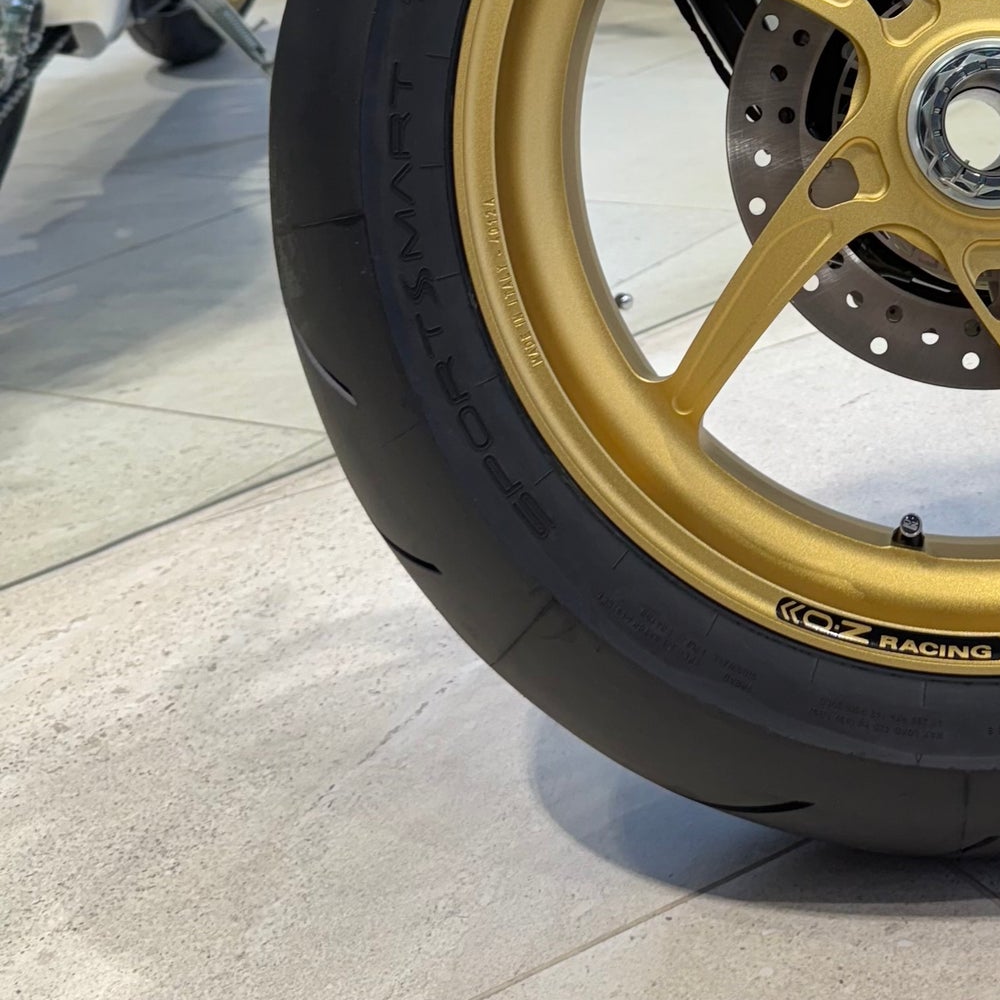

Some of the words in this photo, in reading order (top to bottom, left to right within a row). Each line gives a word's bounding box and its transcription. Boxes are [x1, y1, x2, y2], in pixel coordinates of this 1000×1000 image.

[387, 61, 552, 539] SPORTSMART
[495, 263, 518, 307] ITALY
[511, 311, 526, 329] IN
[520, 331, 544, 368] MADE
[879, 634, 993, 659] RACING
